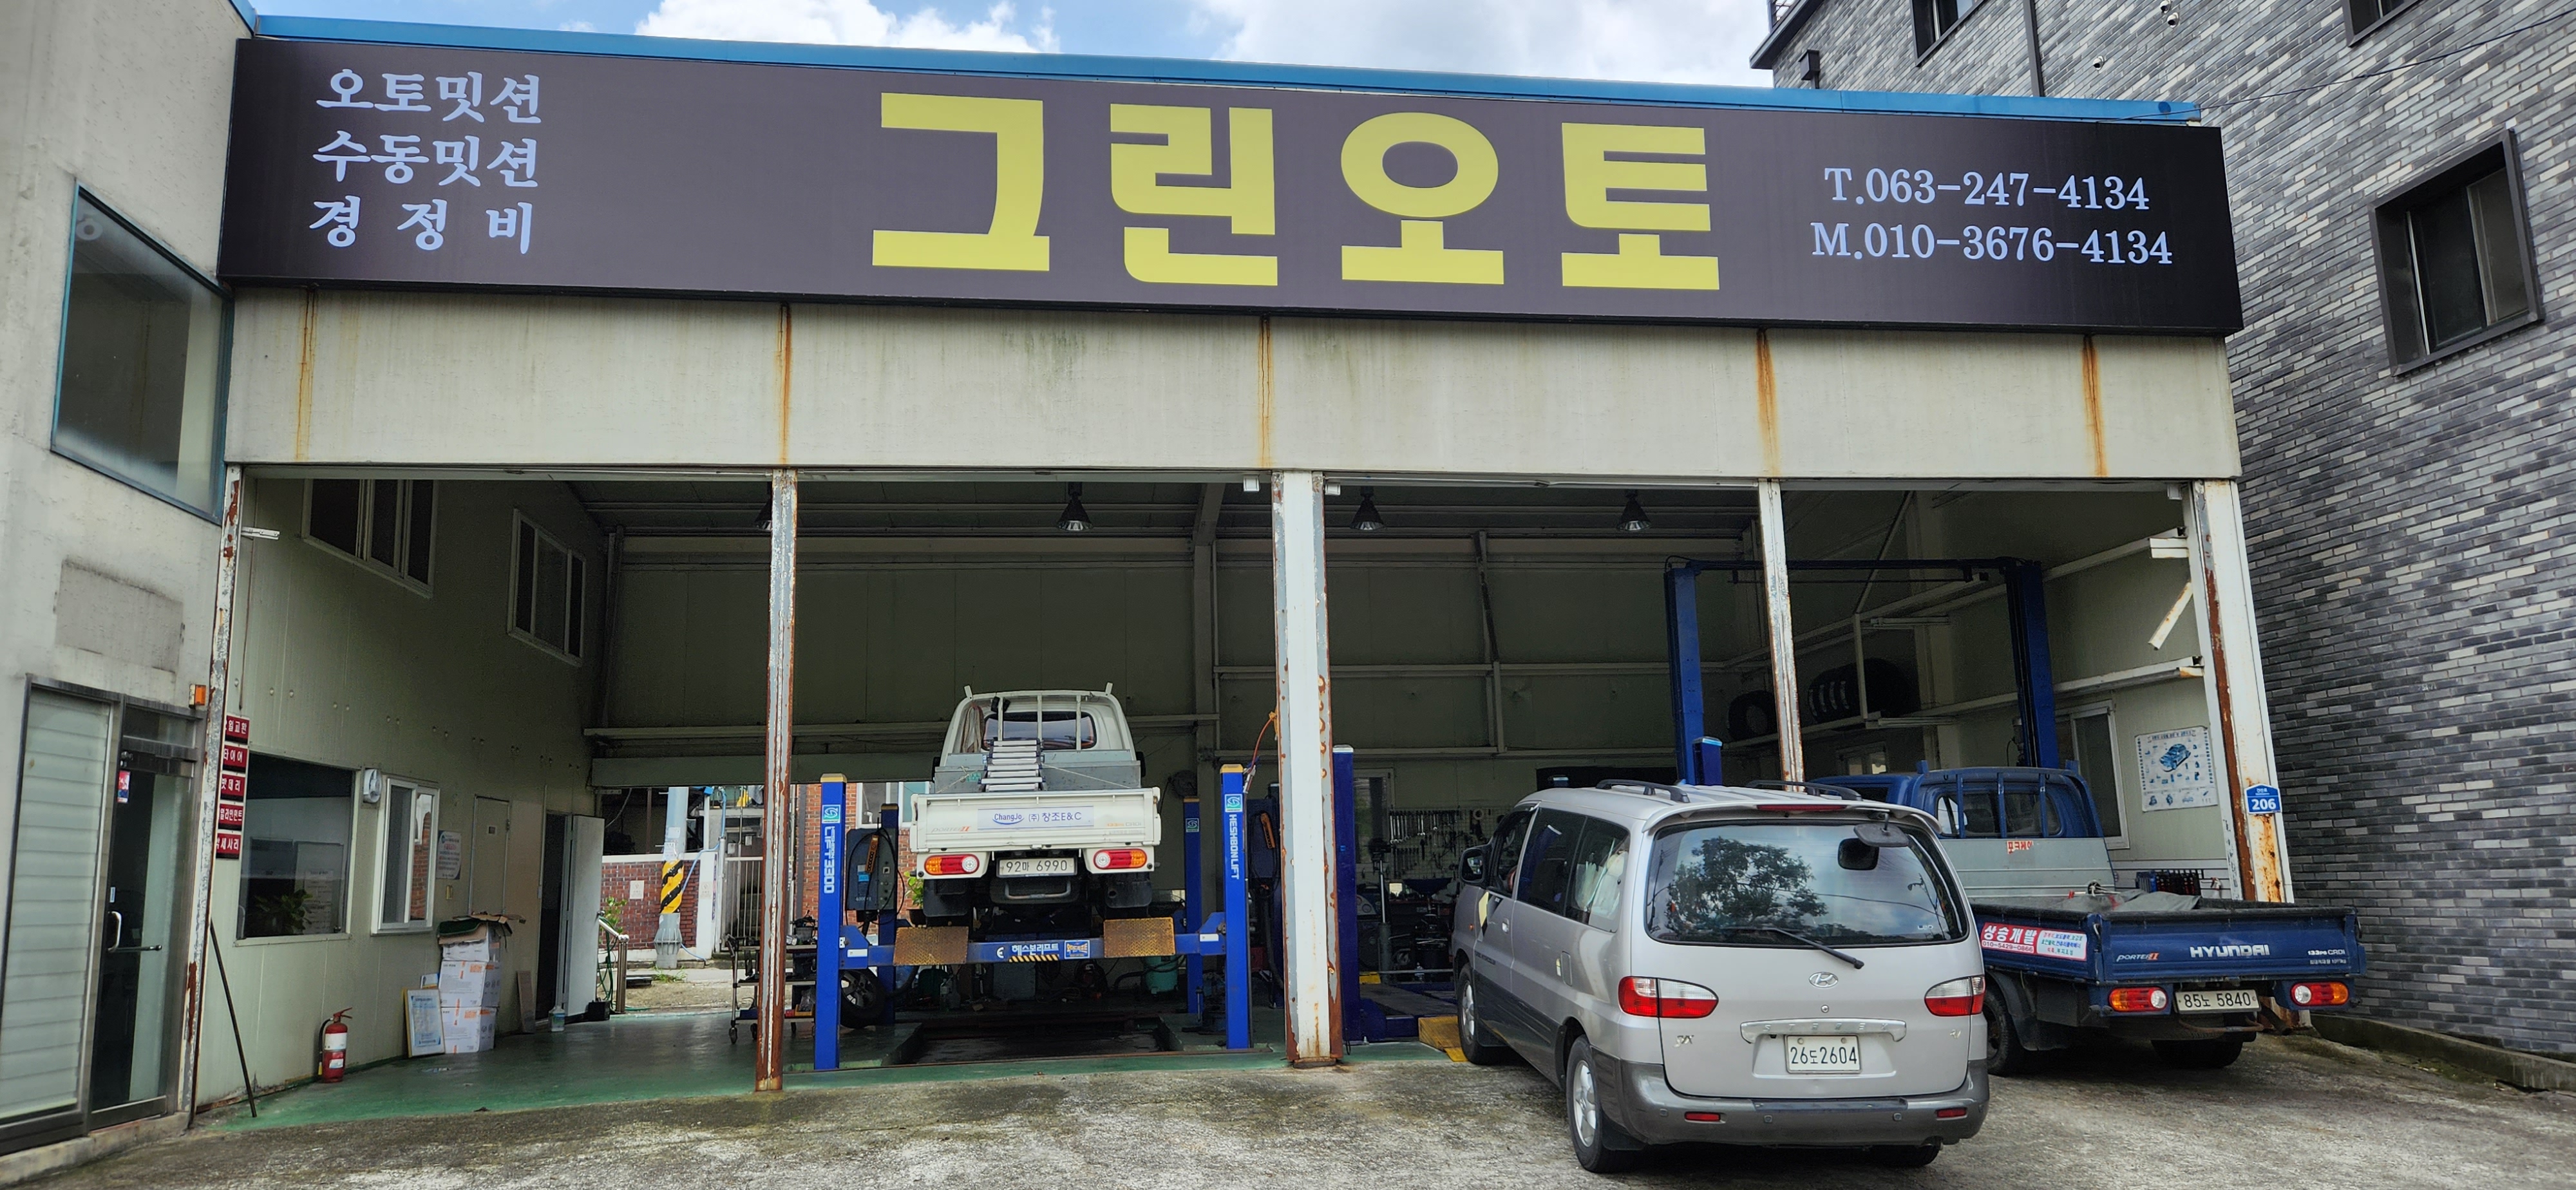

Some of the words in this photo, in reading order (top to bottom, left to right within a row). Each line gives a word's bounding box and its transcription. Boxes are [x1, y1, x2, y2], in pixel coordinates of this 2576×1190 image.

[316, 68, 542, 124] 오토밋션
[312, 130, 538, 188] 수동밋션
[873, 92, 1720, 291] 그린오토
[1824, 167, 2150, 210] T.063-247-4134
[1810, 222, 2172, 265] M.010-3676-4134
[2251, 798, 2277, 811] 206
[994, 813, 1023, 822] ChangJo
[1028, 813, 1040, 822] (주)
[1041, 811, 1082, 822] 창조E&C
[1006, 860, 1030, 873] 92마
[1036, 860, 1067, 871] 6990
[1984, 924, 2038, 945] 상승개발
[1011, 943, 1059, 956] 헤스본리프트
[1982, 941, 2033, 952] 010-5429-0866
[2190, 944, 2270, 958] HYUNDAI
[2184, 994, 2211, 1008] 85노
[2216, 992, 2251, 1007] 5840
[1790, 1046, 1857, 1064] 26도2604
